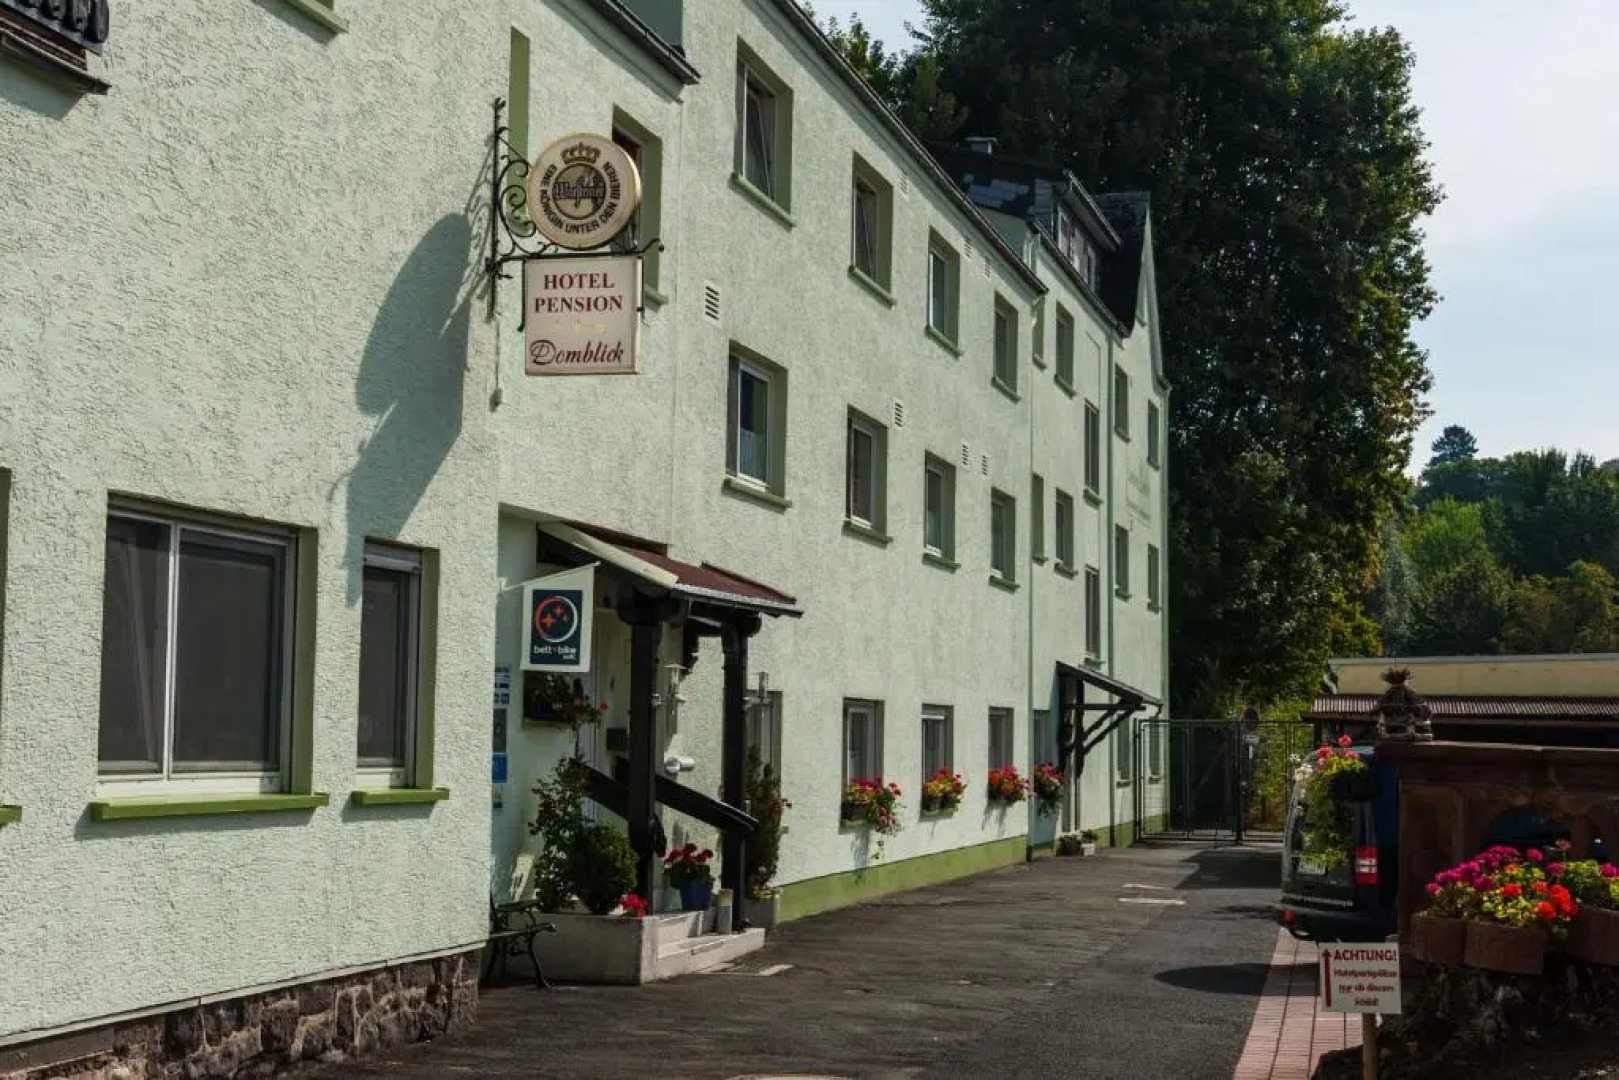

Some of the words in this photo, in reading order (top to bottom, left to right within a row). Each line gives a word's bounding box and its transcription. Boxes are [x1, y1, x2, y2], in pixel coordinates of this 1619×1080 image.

[541, 164, 557, 187] EINE
[602, 161, 621, 200] BIEREN
[599, 201, 618, 224] DEN
[565, 219, 600, 234] UNTER
[544, 273, 614, 290] HOTEL
[534, 295, 623, 313] PENSION
[530, 340, 624, 366] Domblick
[1334, 949, 1397, 962] ACHTUNG!
